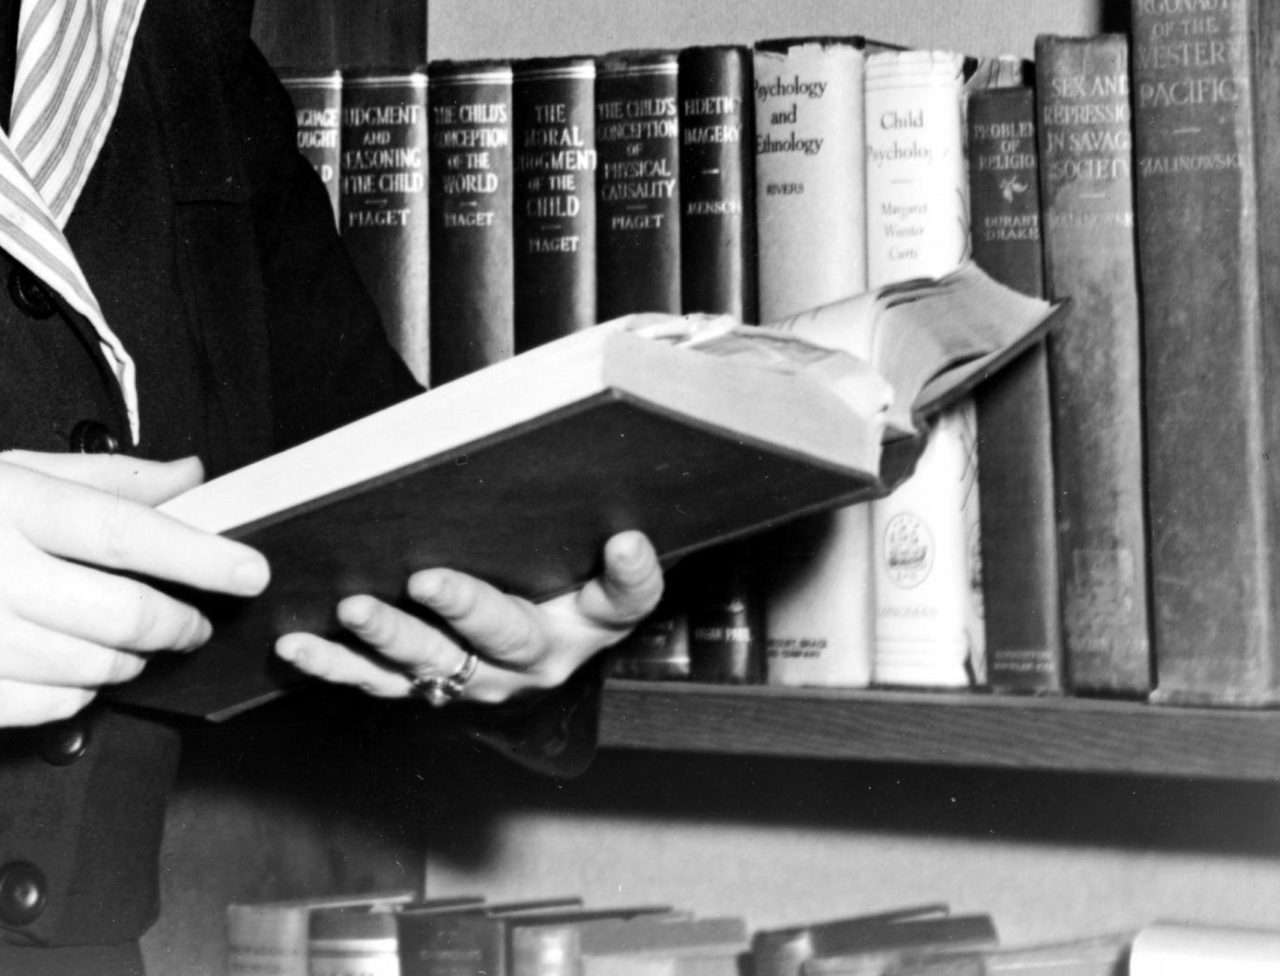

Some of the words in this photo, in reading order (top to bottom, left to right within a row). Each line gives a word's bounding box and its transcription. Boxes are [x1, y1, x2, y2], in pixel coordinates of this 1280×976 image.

[1051, 75, 1086, 97] SEX
[1139, 79, 1238, 108] PACIFIC
[535, 103, 566, 123] THE
[598, 101, 624, 119] THE
[771, 103, 797, 125] and
[881, 109, 924, 130] Child
[363, 131, 391, 145] AND
[524, 125, 584, 147] MORAL
[598, 117, 679, 141] CONCEPTION
[684, 125, 741, 145] IMAGERY
[627, 143, 643, 157] OF
[1001, 139, 1020, 153] OF
[447, 153, 462, 169] OF
[467, 151, 490, 169] THE
[604, 158, 672, 179] PHYSICAL
[379, 172, 424, 193] CHILD
[443, 172, 499, 194] WORLD
[528, 177, 542, 191] OF
[549, 175, 576, 191] THE
[601, 178, 676, 201] CAUSALITY
[767, 182, 804, 196] RIVERS
[526, 195, 580, 217] CHILD
[349, 209, 411, 227] PIAGET
[444, 211, 495, 227] PIAGET
[611, 213, 664, 230] PIAGET
[985, 227, 1040, 241] DRAKE
[529, 236, 580, 253] PIAGET
